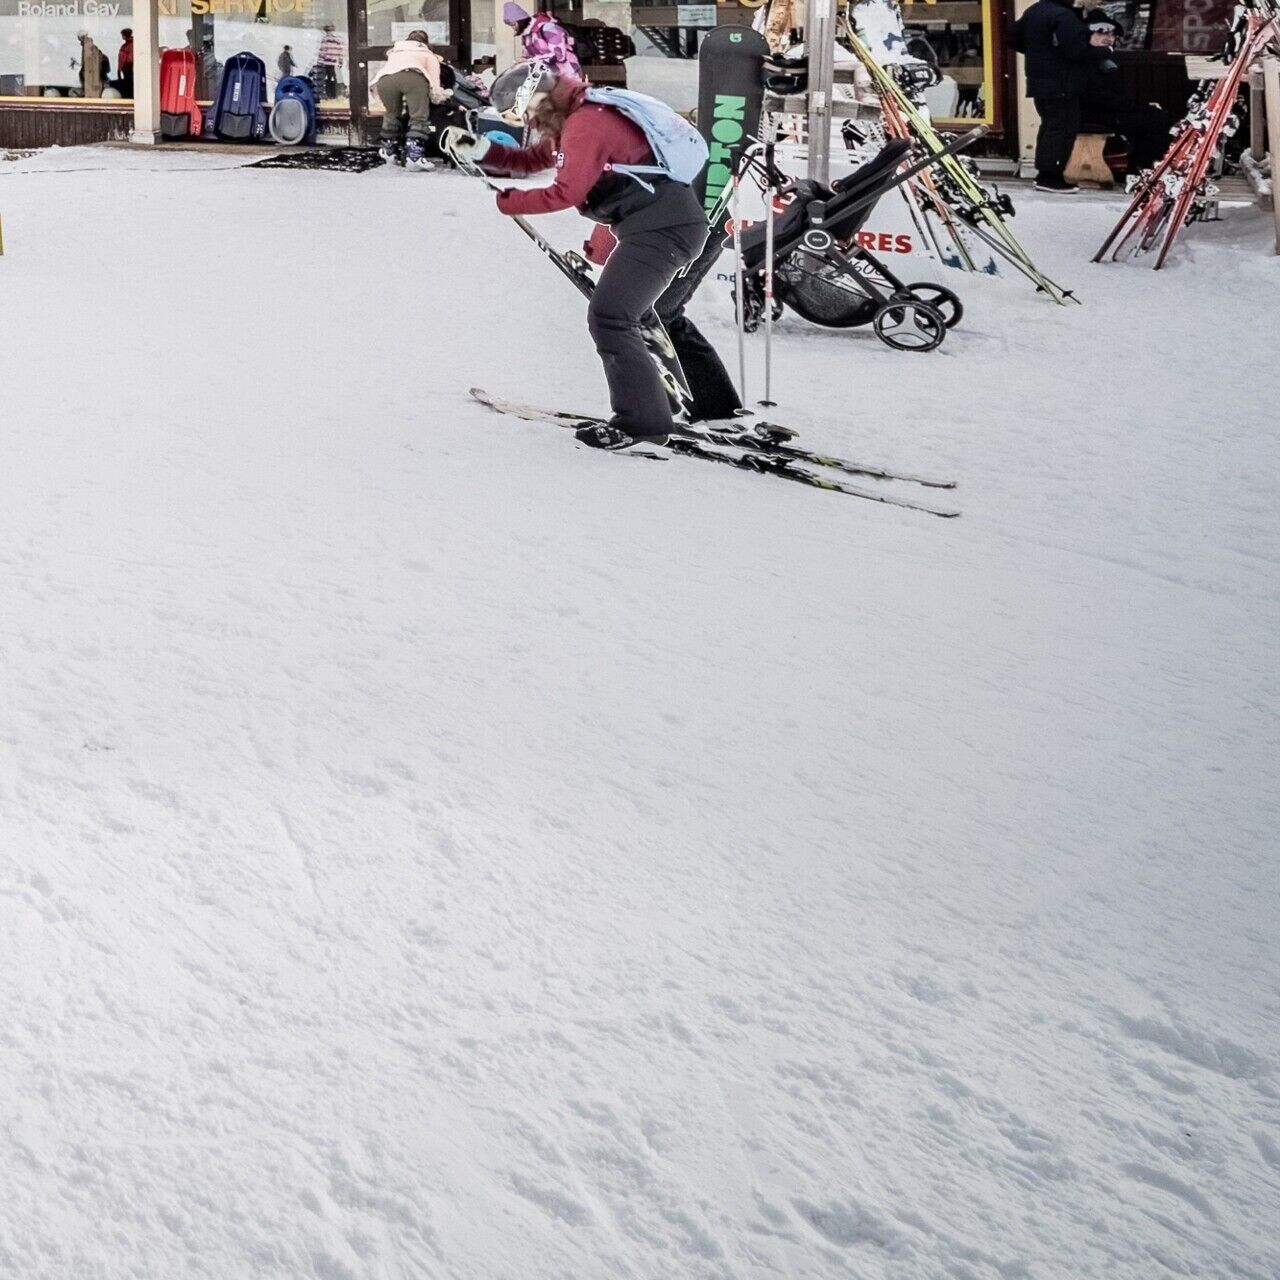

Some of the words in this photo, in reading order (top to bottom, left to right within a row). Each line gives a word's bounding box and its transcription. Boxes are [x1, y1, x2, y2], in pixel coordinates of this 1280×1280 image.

[17, 0, 79, 17] Roland
[83, 0, 120, 18] Gay
[703, 93, 746, 216] URTON
